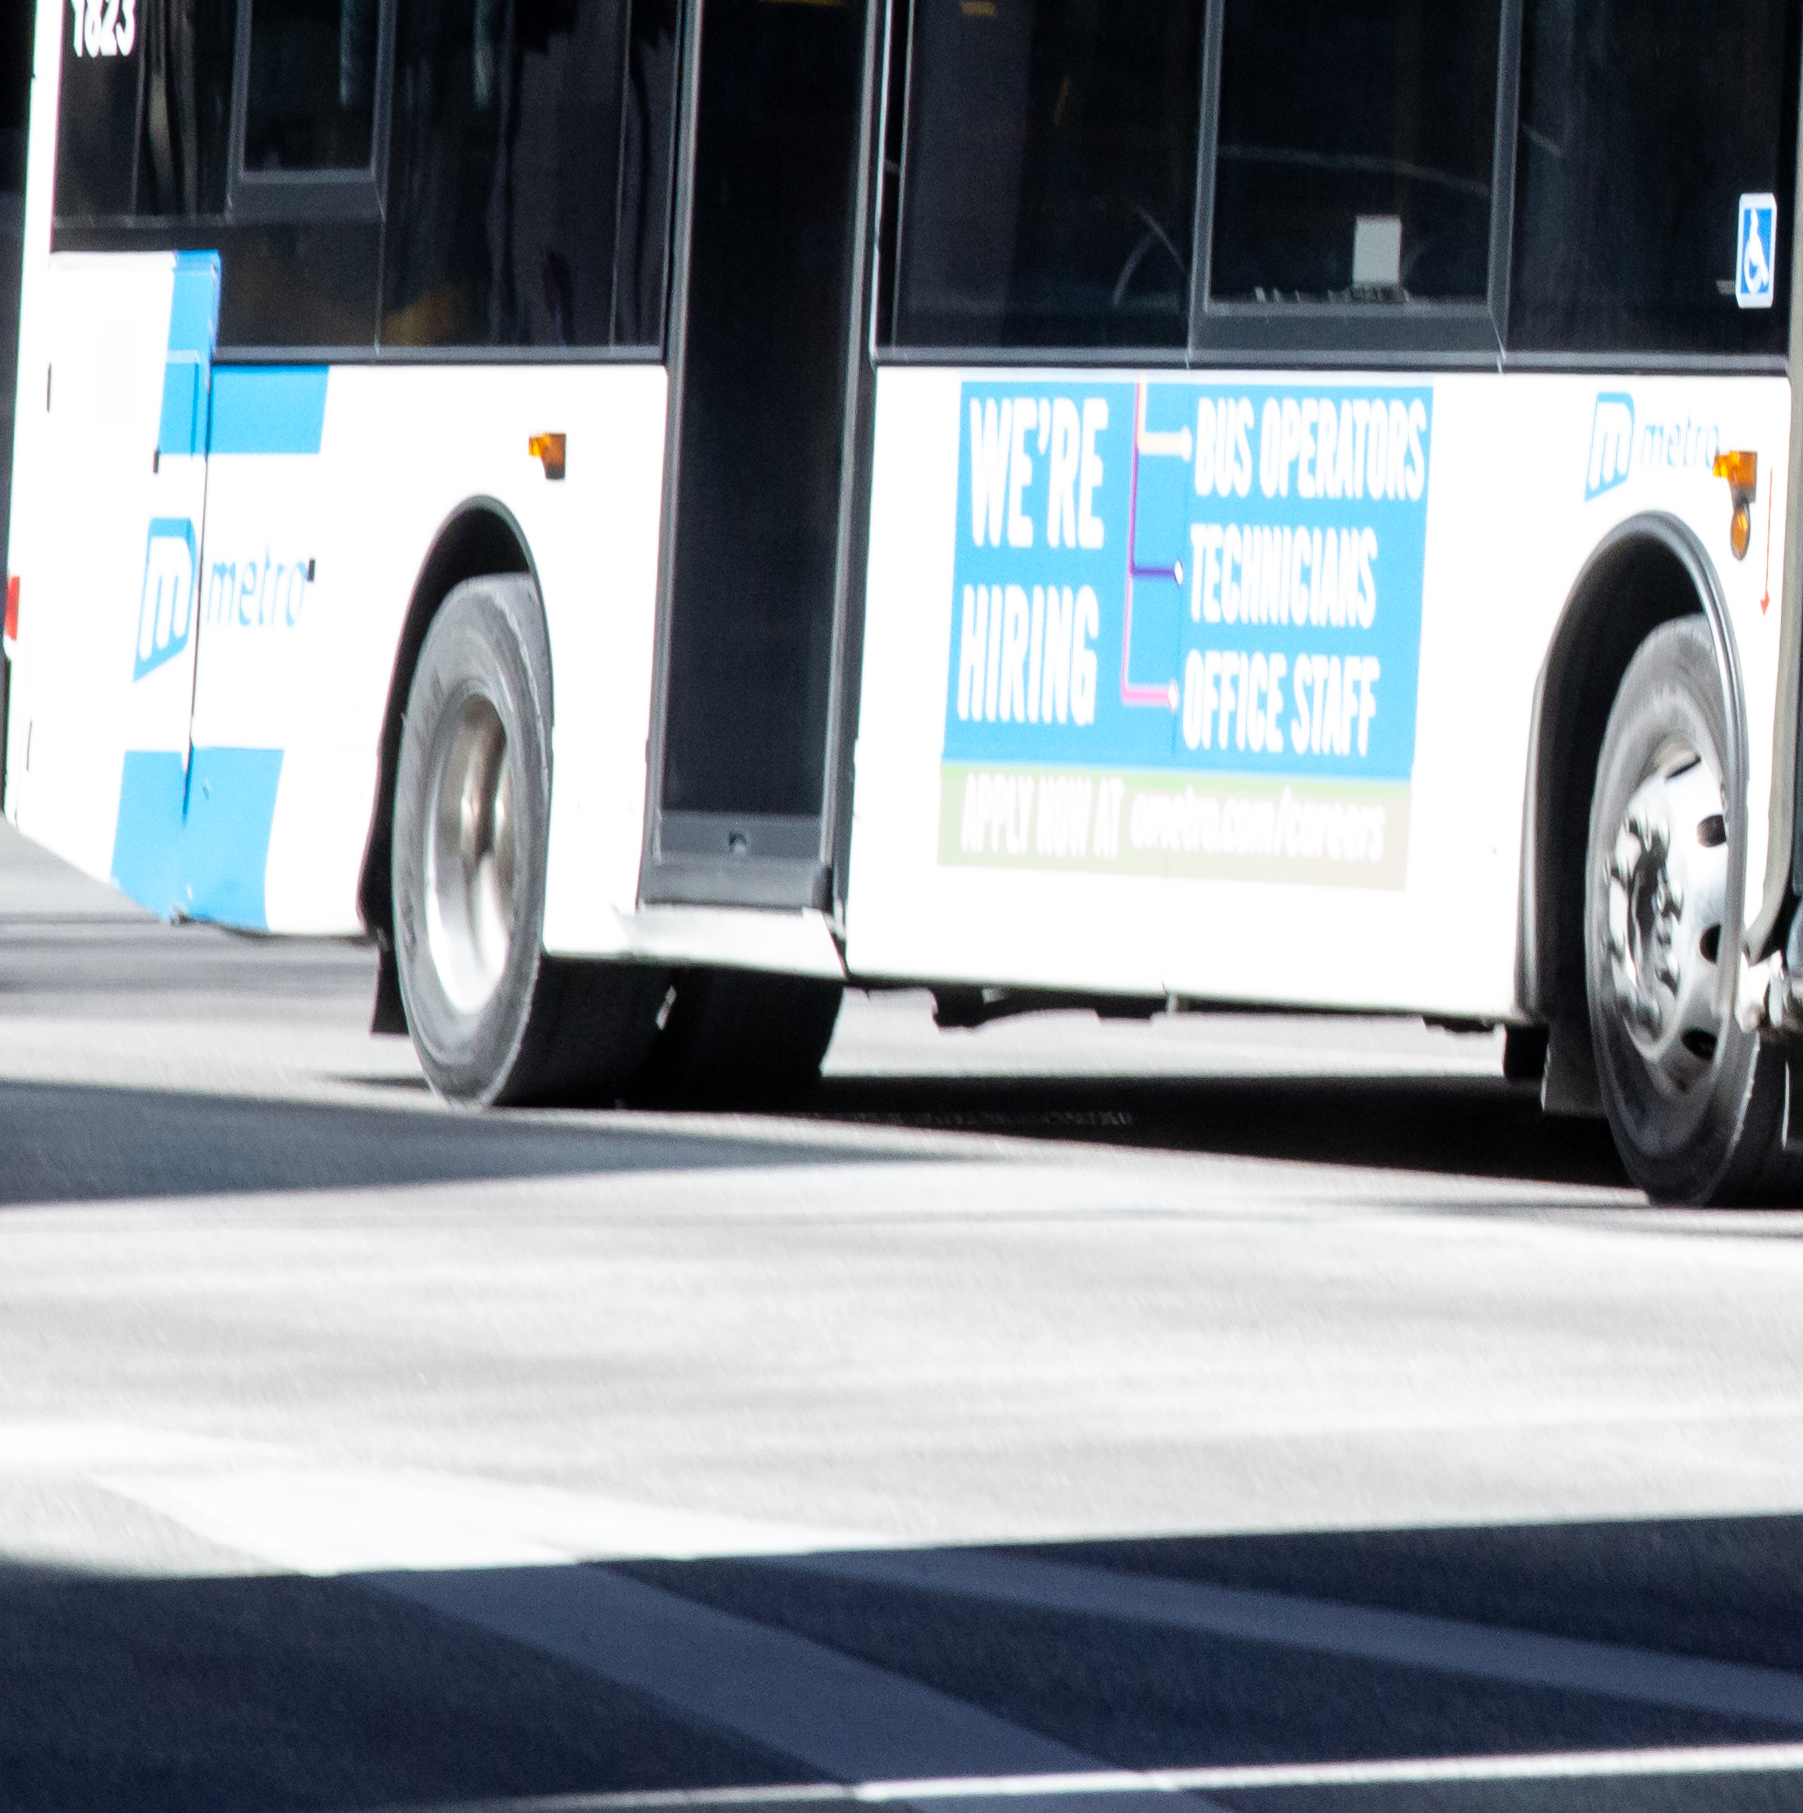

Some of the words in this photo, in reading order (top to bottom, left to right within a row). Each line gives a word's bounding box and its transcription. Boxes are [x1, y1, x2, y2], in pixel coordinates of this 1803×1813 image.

[969, 396, 1110, 550] WE'RE
[1194, 396, 1255, 498] BUS
[1259, 397, 1428, 503] OPERATORS
[1640, 415, 1721, 471] metro
[206, 543, 309, 627] metro
[1190, 522, 1379, 630] TECHNICIANS
[956, 583, 1098, 727] HIRING
[1181, 648, 1288, 754] OFFICE
[1290, 652, 1381, 758] STAFF
[960, 772, 1034, 855] APPLY
[1036, 772, 1092, 859] NOW
[1094, 775, 1125, 861] AT
[1130, 783, 1387, 864] ometro.com/careers
